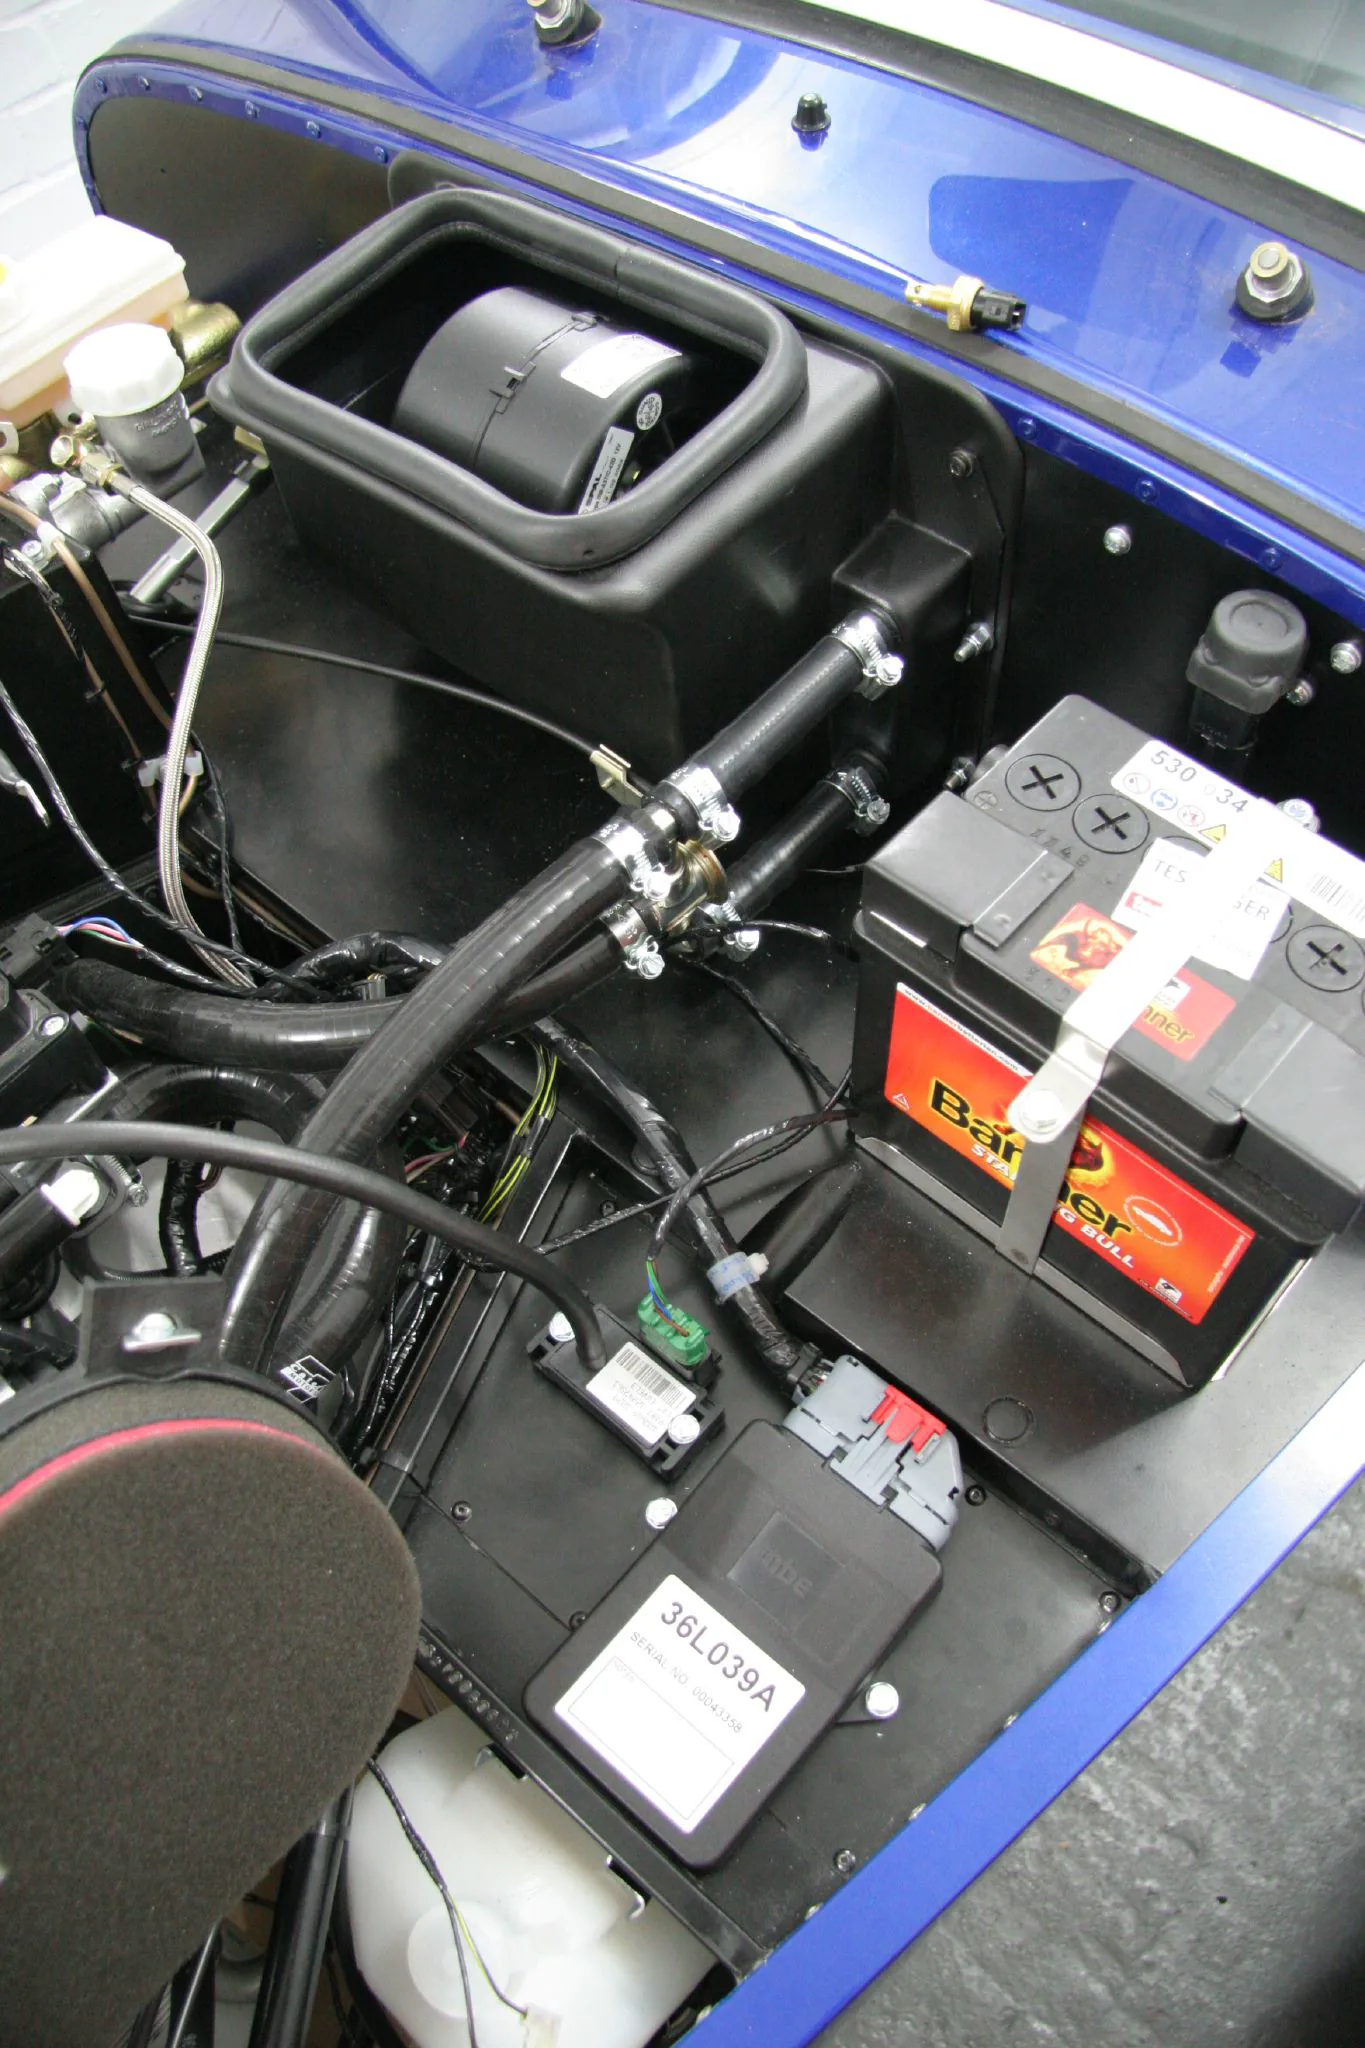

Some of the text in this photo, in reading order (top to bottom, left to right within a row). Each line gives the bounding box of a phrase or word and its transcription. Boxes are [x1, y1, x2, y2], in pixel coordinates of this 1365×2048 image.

[1151, 750, 1197, 782] 530
[1080, 1224, 1134, 1269] BULL
[630, 1631, 668, 1668] SERIAL
[661, 1601, 776, 1712] 36L039A
